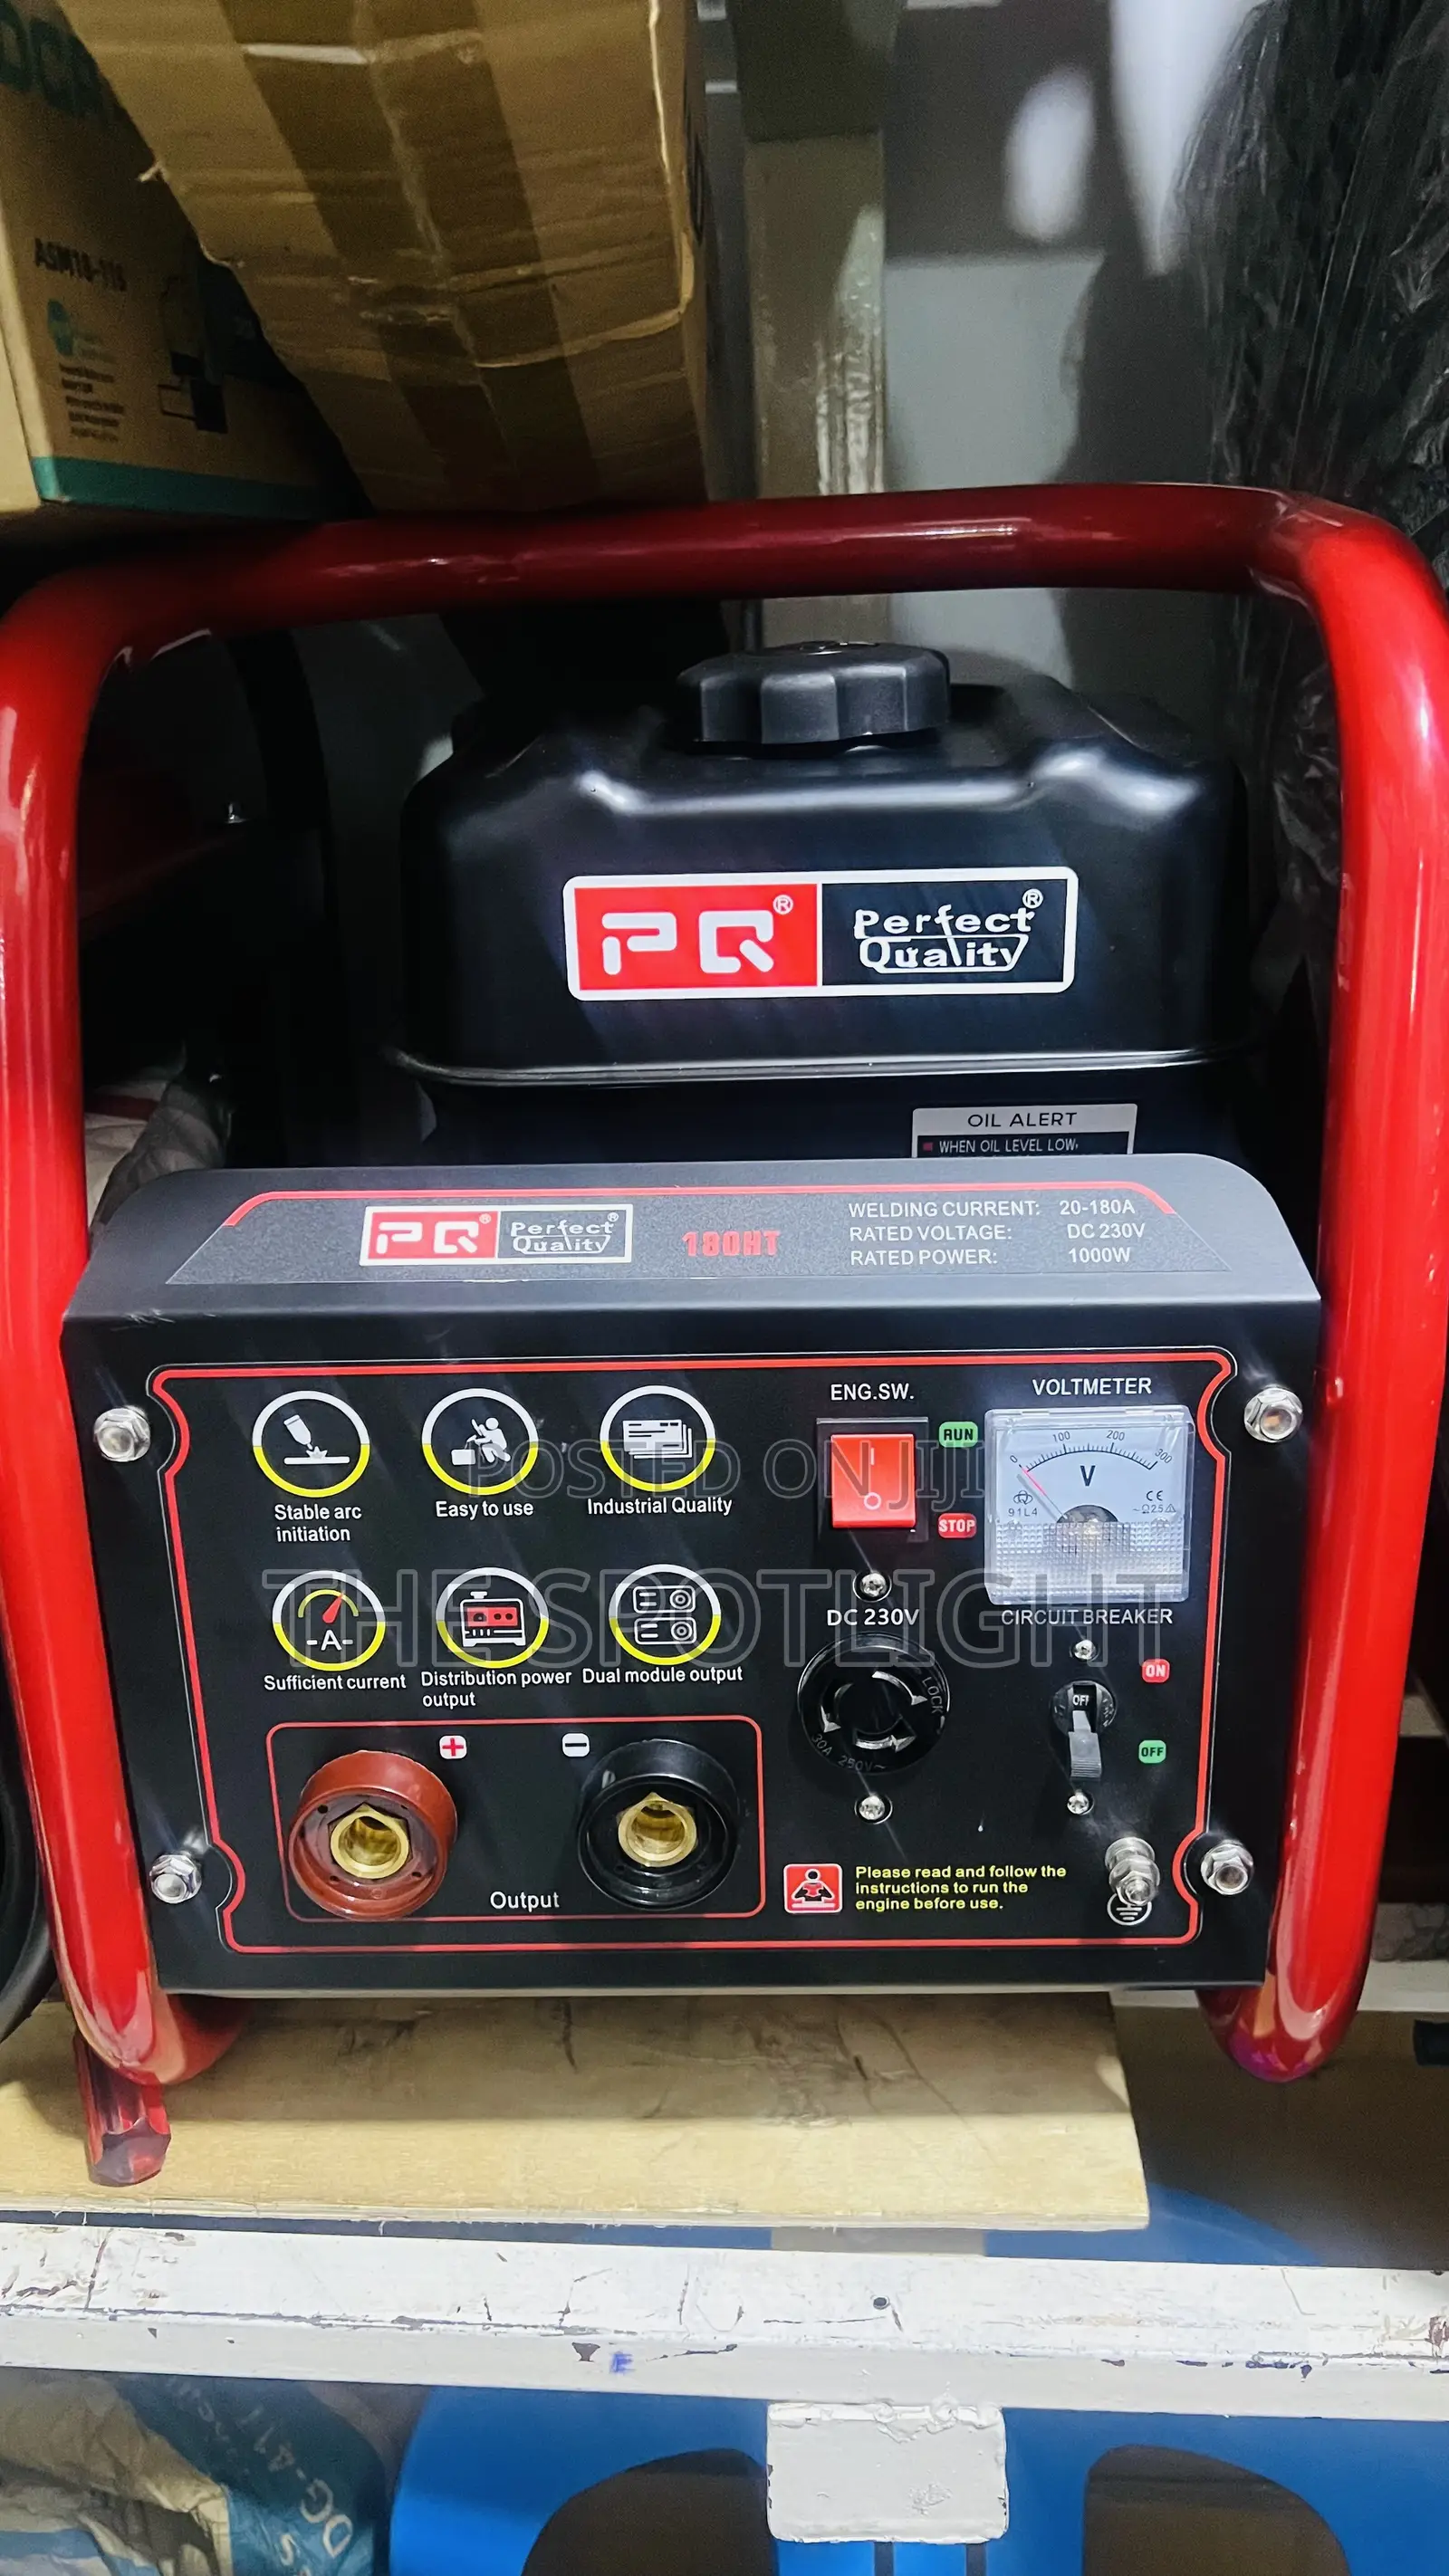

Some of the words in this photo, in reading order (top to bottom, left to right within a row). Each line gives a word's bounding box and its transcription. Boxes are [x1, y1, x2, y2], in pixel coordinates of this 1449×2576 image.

[854, 904, 1031, 940] Perfect
[601, 911, 774, 976] PQ
[859, 938, 1025, 974] Quality
[967, 1113, 1002, 1128] OIL
[1010, 1112, 1078, 1126] ALERT
[939, 1140, 975, 1154] WHEN
[980, 1139, 1000, 1153] OIL
[1005, 1138, 1043, 1153] LEVEL
[849, 1202, 938, 1217] WELDING
[942, 1200, 1041, 1216] CURRENT:
[1059, 1199, 1136, 1215] 20-180A
[510, 1219, 616, 1237] Perfect
[849, 1226, 913, 1241] RATED
[916, 1224, 1012, 1240] VOLTAGE:
[1067, 1222, 1095, 1238] DC
[1099, 1222, 1146, 1238] 230V
[377, 1221, 478, 1255] PQ
[512, 1233, 610, 1254] Quality
[682, 1230, 782, 1257] 180HT
[850, 1250, 914, 1265] RATED
[919, 1249, 998, 1265] POWER:
[1069, 1247, 1131, 1262] 1000W
[830, 1384, 915, 1402] ENG.SW.
[1032, 1377, 1153, 1396] VOLTMETER
[944, 1428, 974, 1441] RUN
[1052, 1431, 1071, 1443] 100
[1106, 1430, 1126, 1442] 200
[1009, 1454, 1019, 1465] 0
[1154, 1448, 1174, 1465] 300
[1080, 1465, 1097, 1487] V
[273, 1504, 331, 1521] Stable
[334, 1506, 362, 1520] arc
[435, 1500, 479, 1520] Easy
[482, 1502, 500, 1517] to
[504, 1504, 534, 1517] use
[587, 1496, 667, 1516] Industrial
[671, 1496, 734, 1517] Quality
[1008, 1507, 1039, 1518] 91L4
[276, 1526, 351, 1543] initiation
[938, 1518, 975, 1533] STOP
[826, 1609, 858, 1626] DC
[863, 1608, 920, 1626] 230V
[1001, 1609, 1078, 1626] CIRCUIT
[1083, 1608, 1174, 1625] BREAKER
[581, 1668, 623, 1685] Dual
[627, 1668, 686, 1683] module
[688, 1666, 744, 1684] output
[1146, 1663, 1166, 1677] ON
[263, 1674, 342, 1691] Sufficient
[346, 1673, 407, 1690] current
[421, 1671, 518, 1687] Distribution
[521, 1672, 572, 1690] power
[422, 1691, 476, 1708] output
[922, 1676, 944, 1714] LOCK
[1141, 1744, 1165, 1757] OFF
[856, 1865, 911, 1879] Please
[915, 1865, 951, 1879] read
[955, 1865, 985, 1879] and
[990, 1864, 1037, 1878] follow
[1041, 1864, 1067, 1878] the
[856, 1882, 949, 1895] instructions
[954, 1882, 969, 1894] to
[974, 1884, 1002, 1894] run
[1003, 1881, 1029, 1894] the
[490, 1891, 560, 1913] Output
[856, 1898, 908, 1912] engine
[913, 1897, 964, 1910] before
[969, 1900, 1004, 1910] use.
